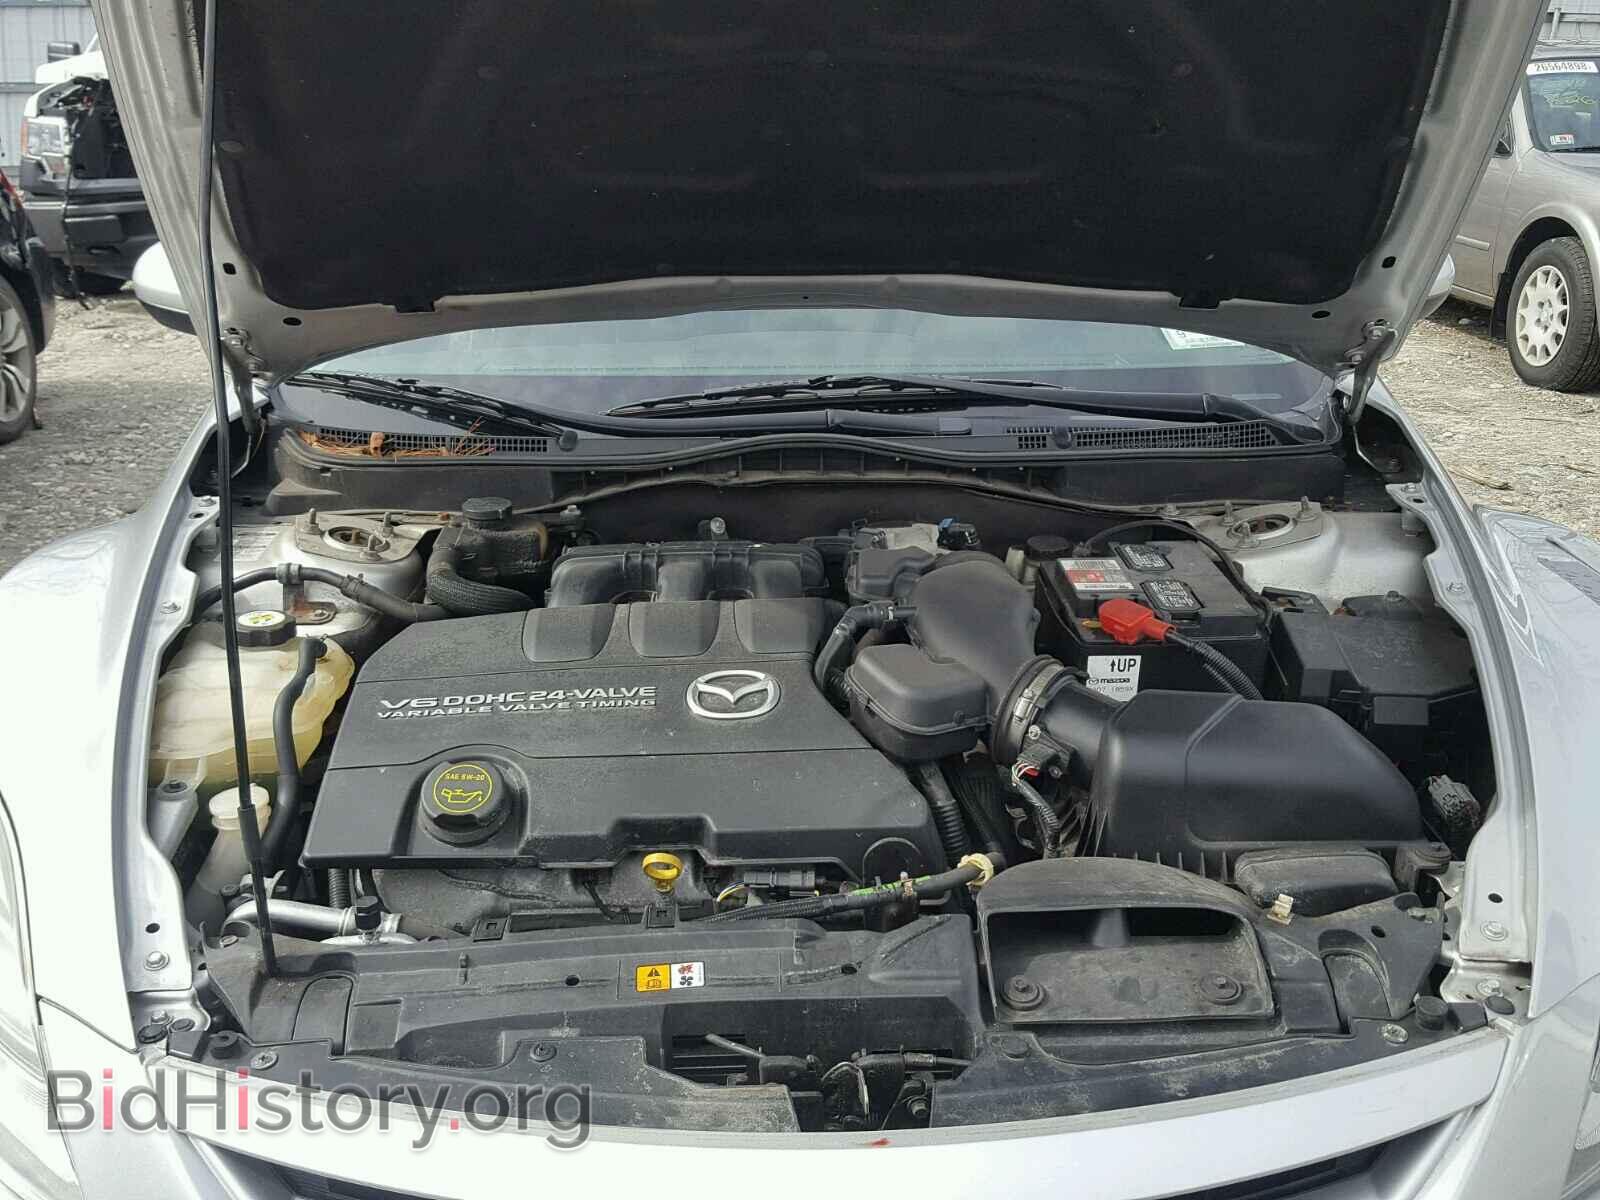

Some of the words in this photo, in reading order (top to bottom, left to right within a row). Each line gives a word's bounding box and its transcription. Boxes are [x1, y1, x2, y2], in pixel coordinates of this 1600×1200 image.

[1117, 658, 1137, 673] UP
[380, 697, 439, 709] V6
[443, 691, 526, 706] DOHC
[529, 686, 657, 701] 24-VALVE
[377, 705, 494, 719] VARIABLE
[499, 701, 571, 712] VALVE
[575, 699, 657, 708] TIMING
